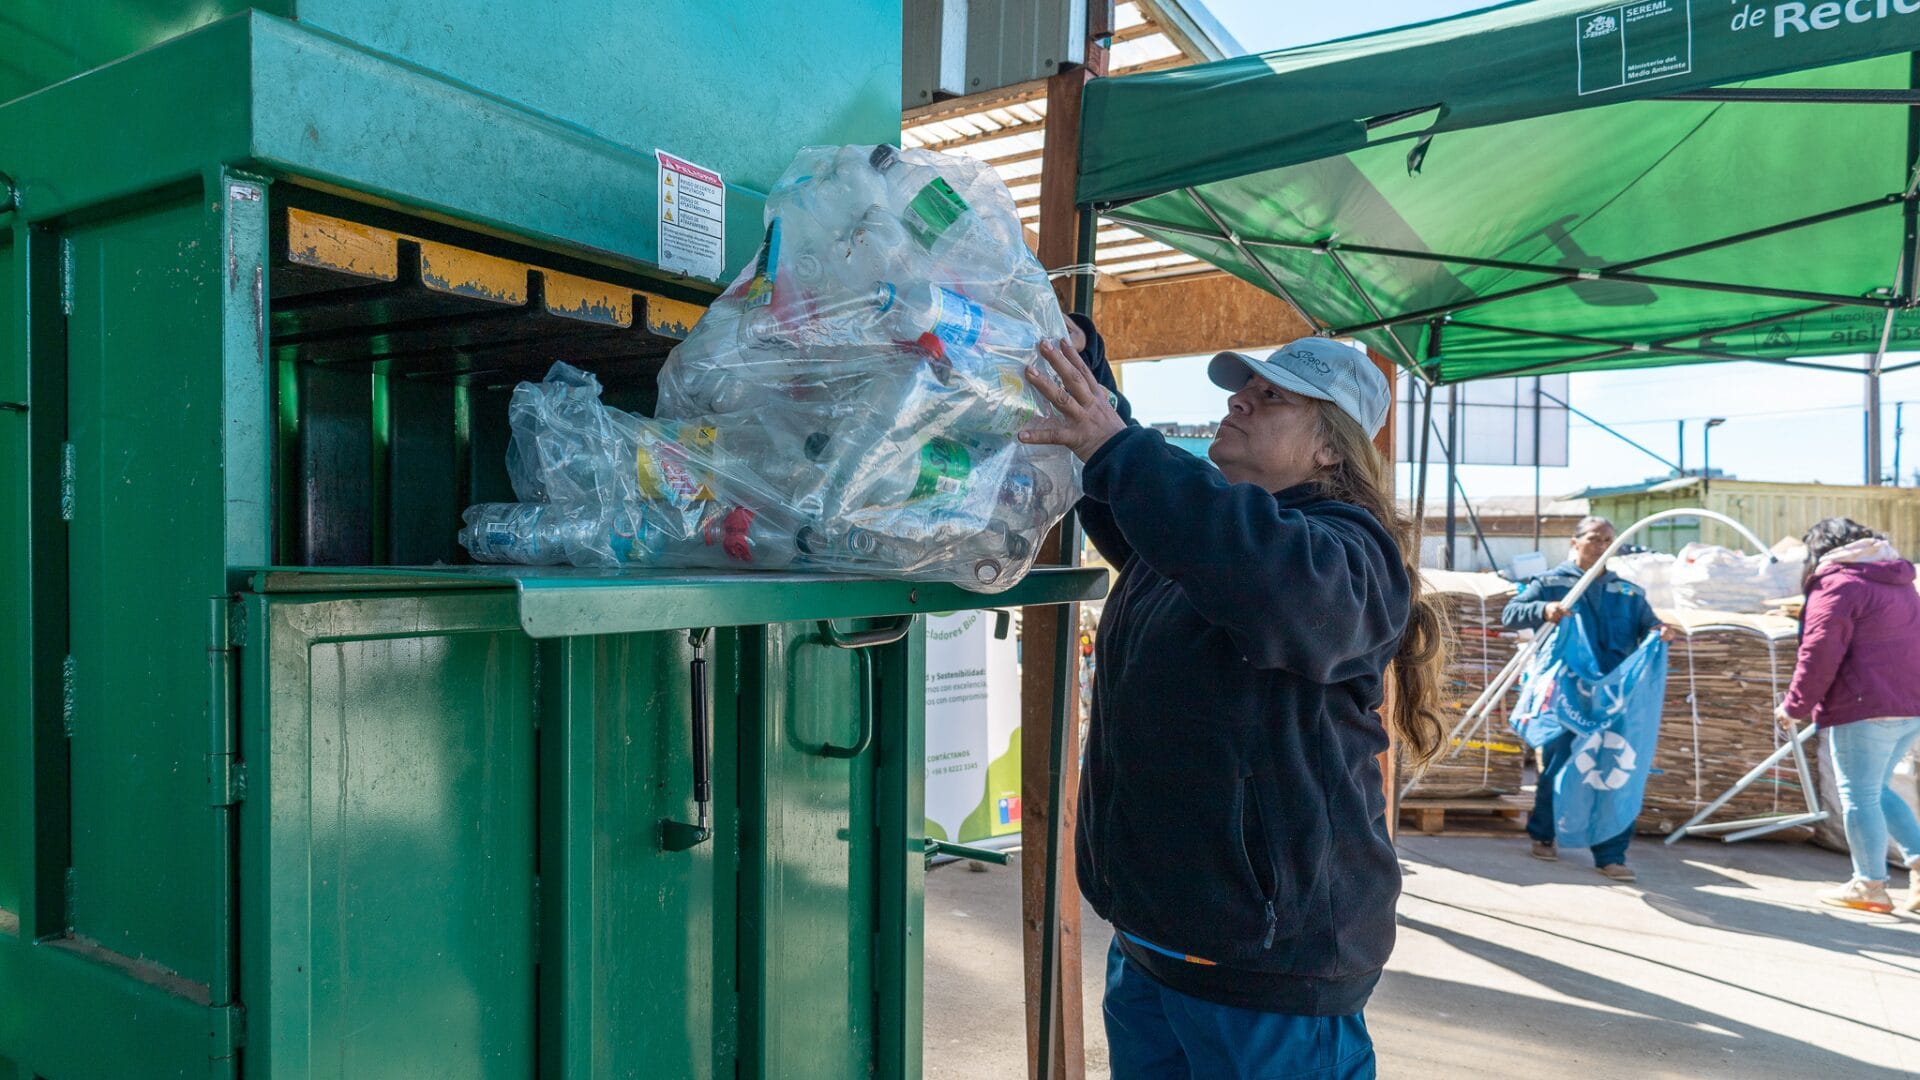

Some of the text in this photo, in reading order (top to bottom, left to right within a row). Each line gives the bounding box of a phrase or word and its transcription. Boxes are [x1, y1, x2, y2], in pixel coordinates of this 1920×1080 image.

[1626, 0, 1666, 17] SEREMI
[1731, 4, 1766, 31] de
[1627, 55, 1677, 71] Ministerio del
[1627, 62, 1686, 79] Medio Ambiente
[927, 750, 970, 762] CONTÁCTANOS
